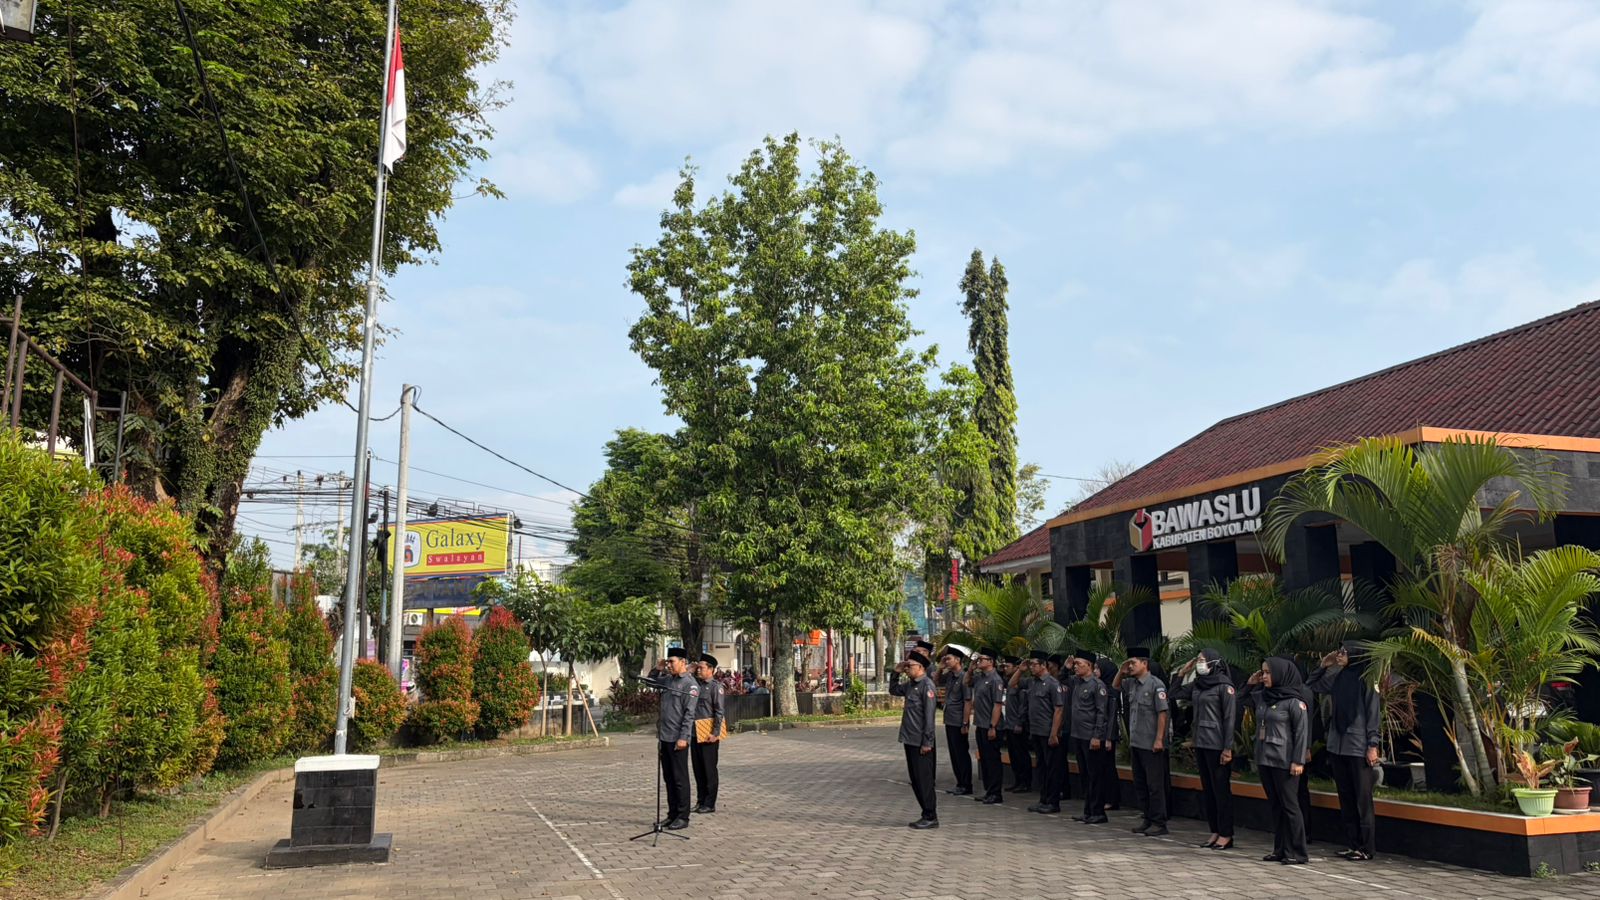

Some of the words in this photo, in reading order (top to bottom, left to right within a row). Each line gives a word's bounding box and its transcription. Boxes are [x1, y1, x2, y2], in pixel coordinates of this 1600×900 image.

[1152, 487, 1261, 535] BAWASLU
[426, 528, 486, 551] Galaxy
[1153, 529, 1206, 549] KABUPATEN
[1207, 518, 1262, 539] BOYOLALI
[428, 553, 483, 564] Swalayan
